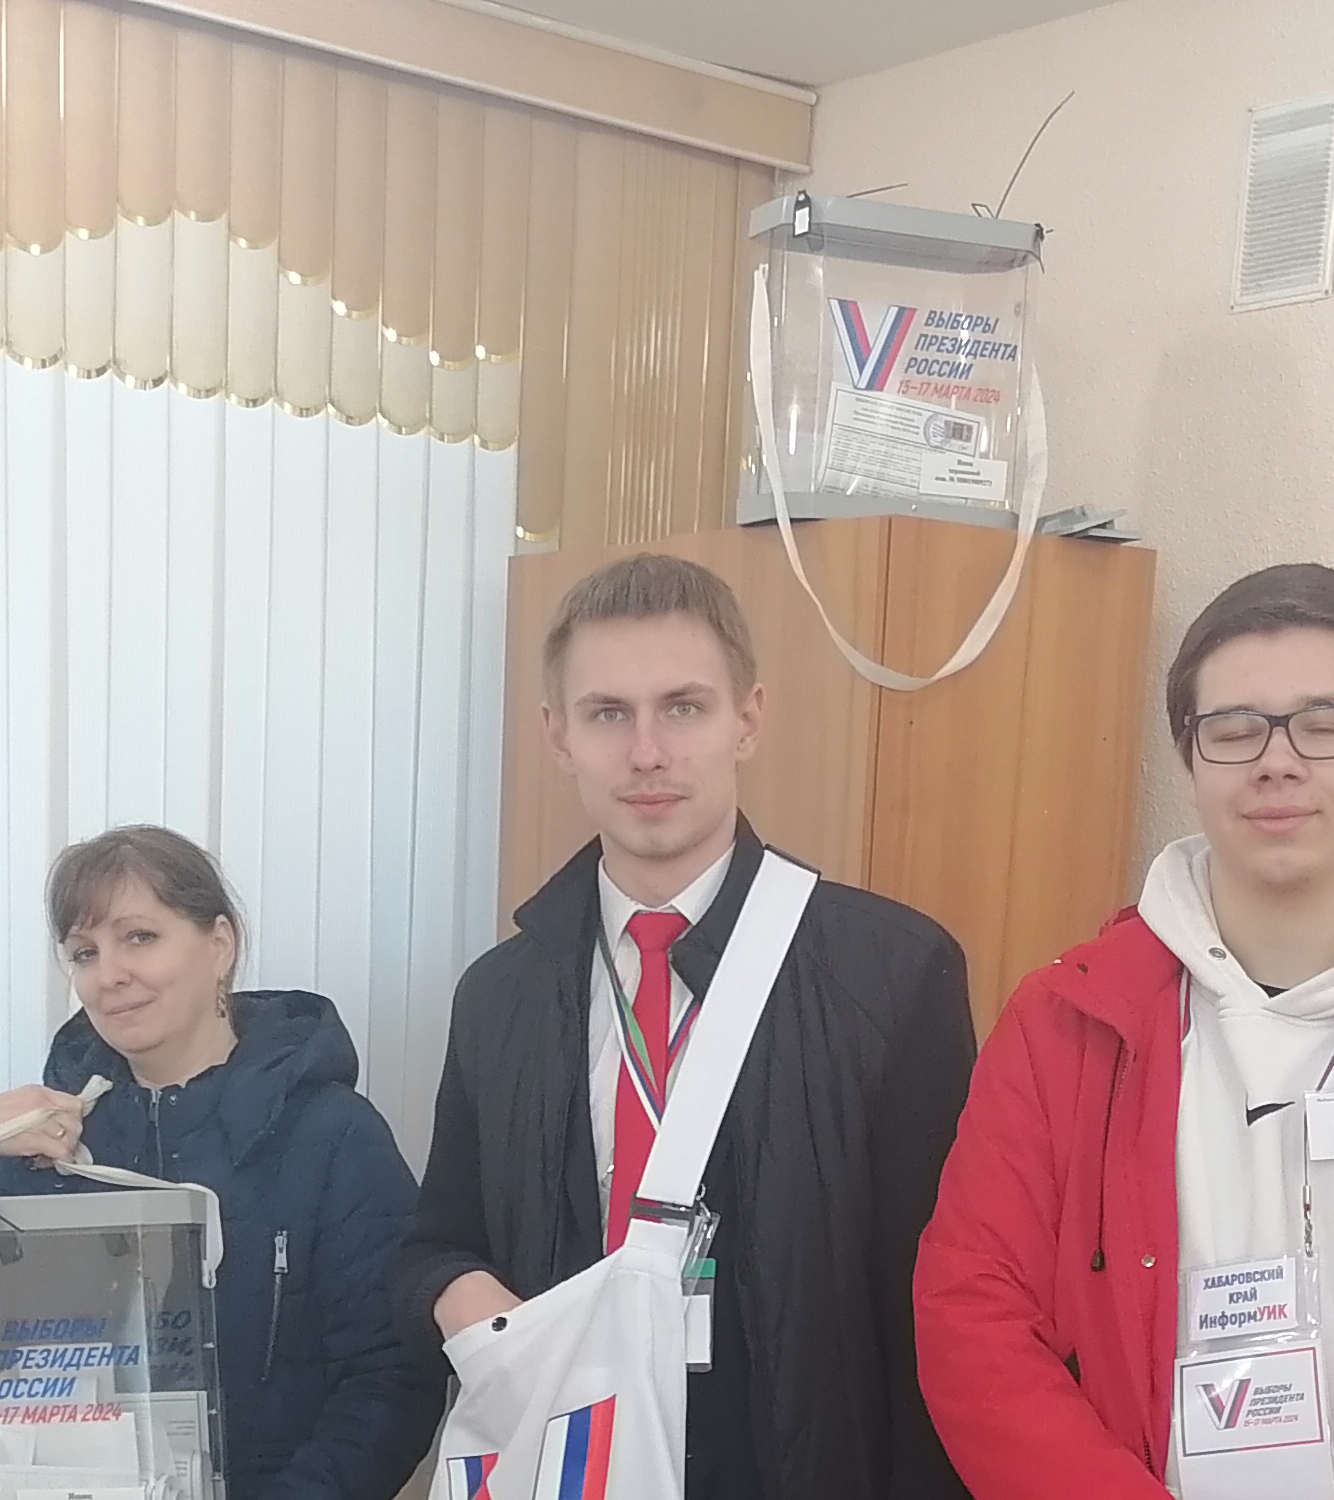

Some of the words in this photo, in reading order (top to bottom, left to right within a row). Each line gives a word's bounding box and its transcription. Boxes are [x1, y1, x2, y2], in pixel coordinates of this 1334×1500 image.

[924, 309, 1000, 335] ВЫБОРЫ
[914, 333, 1018, 362] ПРЕЗИДЕНТА
[904, 356, 974, 380] РОССИИ
[931, 382, 972, 401] МАРТА
[973, 387, 1001, 405] 2024
[1202, 1265, 1284, 1290] ХАБАРОВСКИЙ
[1228, 1287, 1258, 1305] КРАЙ
[1, 1317, 107, 1342] ВЫБОРЫ
[1199, 1303, 1288, 1331] ИнформУИК
[20, 1404, 81, 1425] МАРТА
[81, 1402, 123, 1422] 2024
